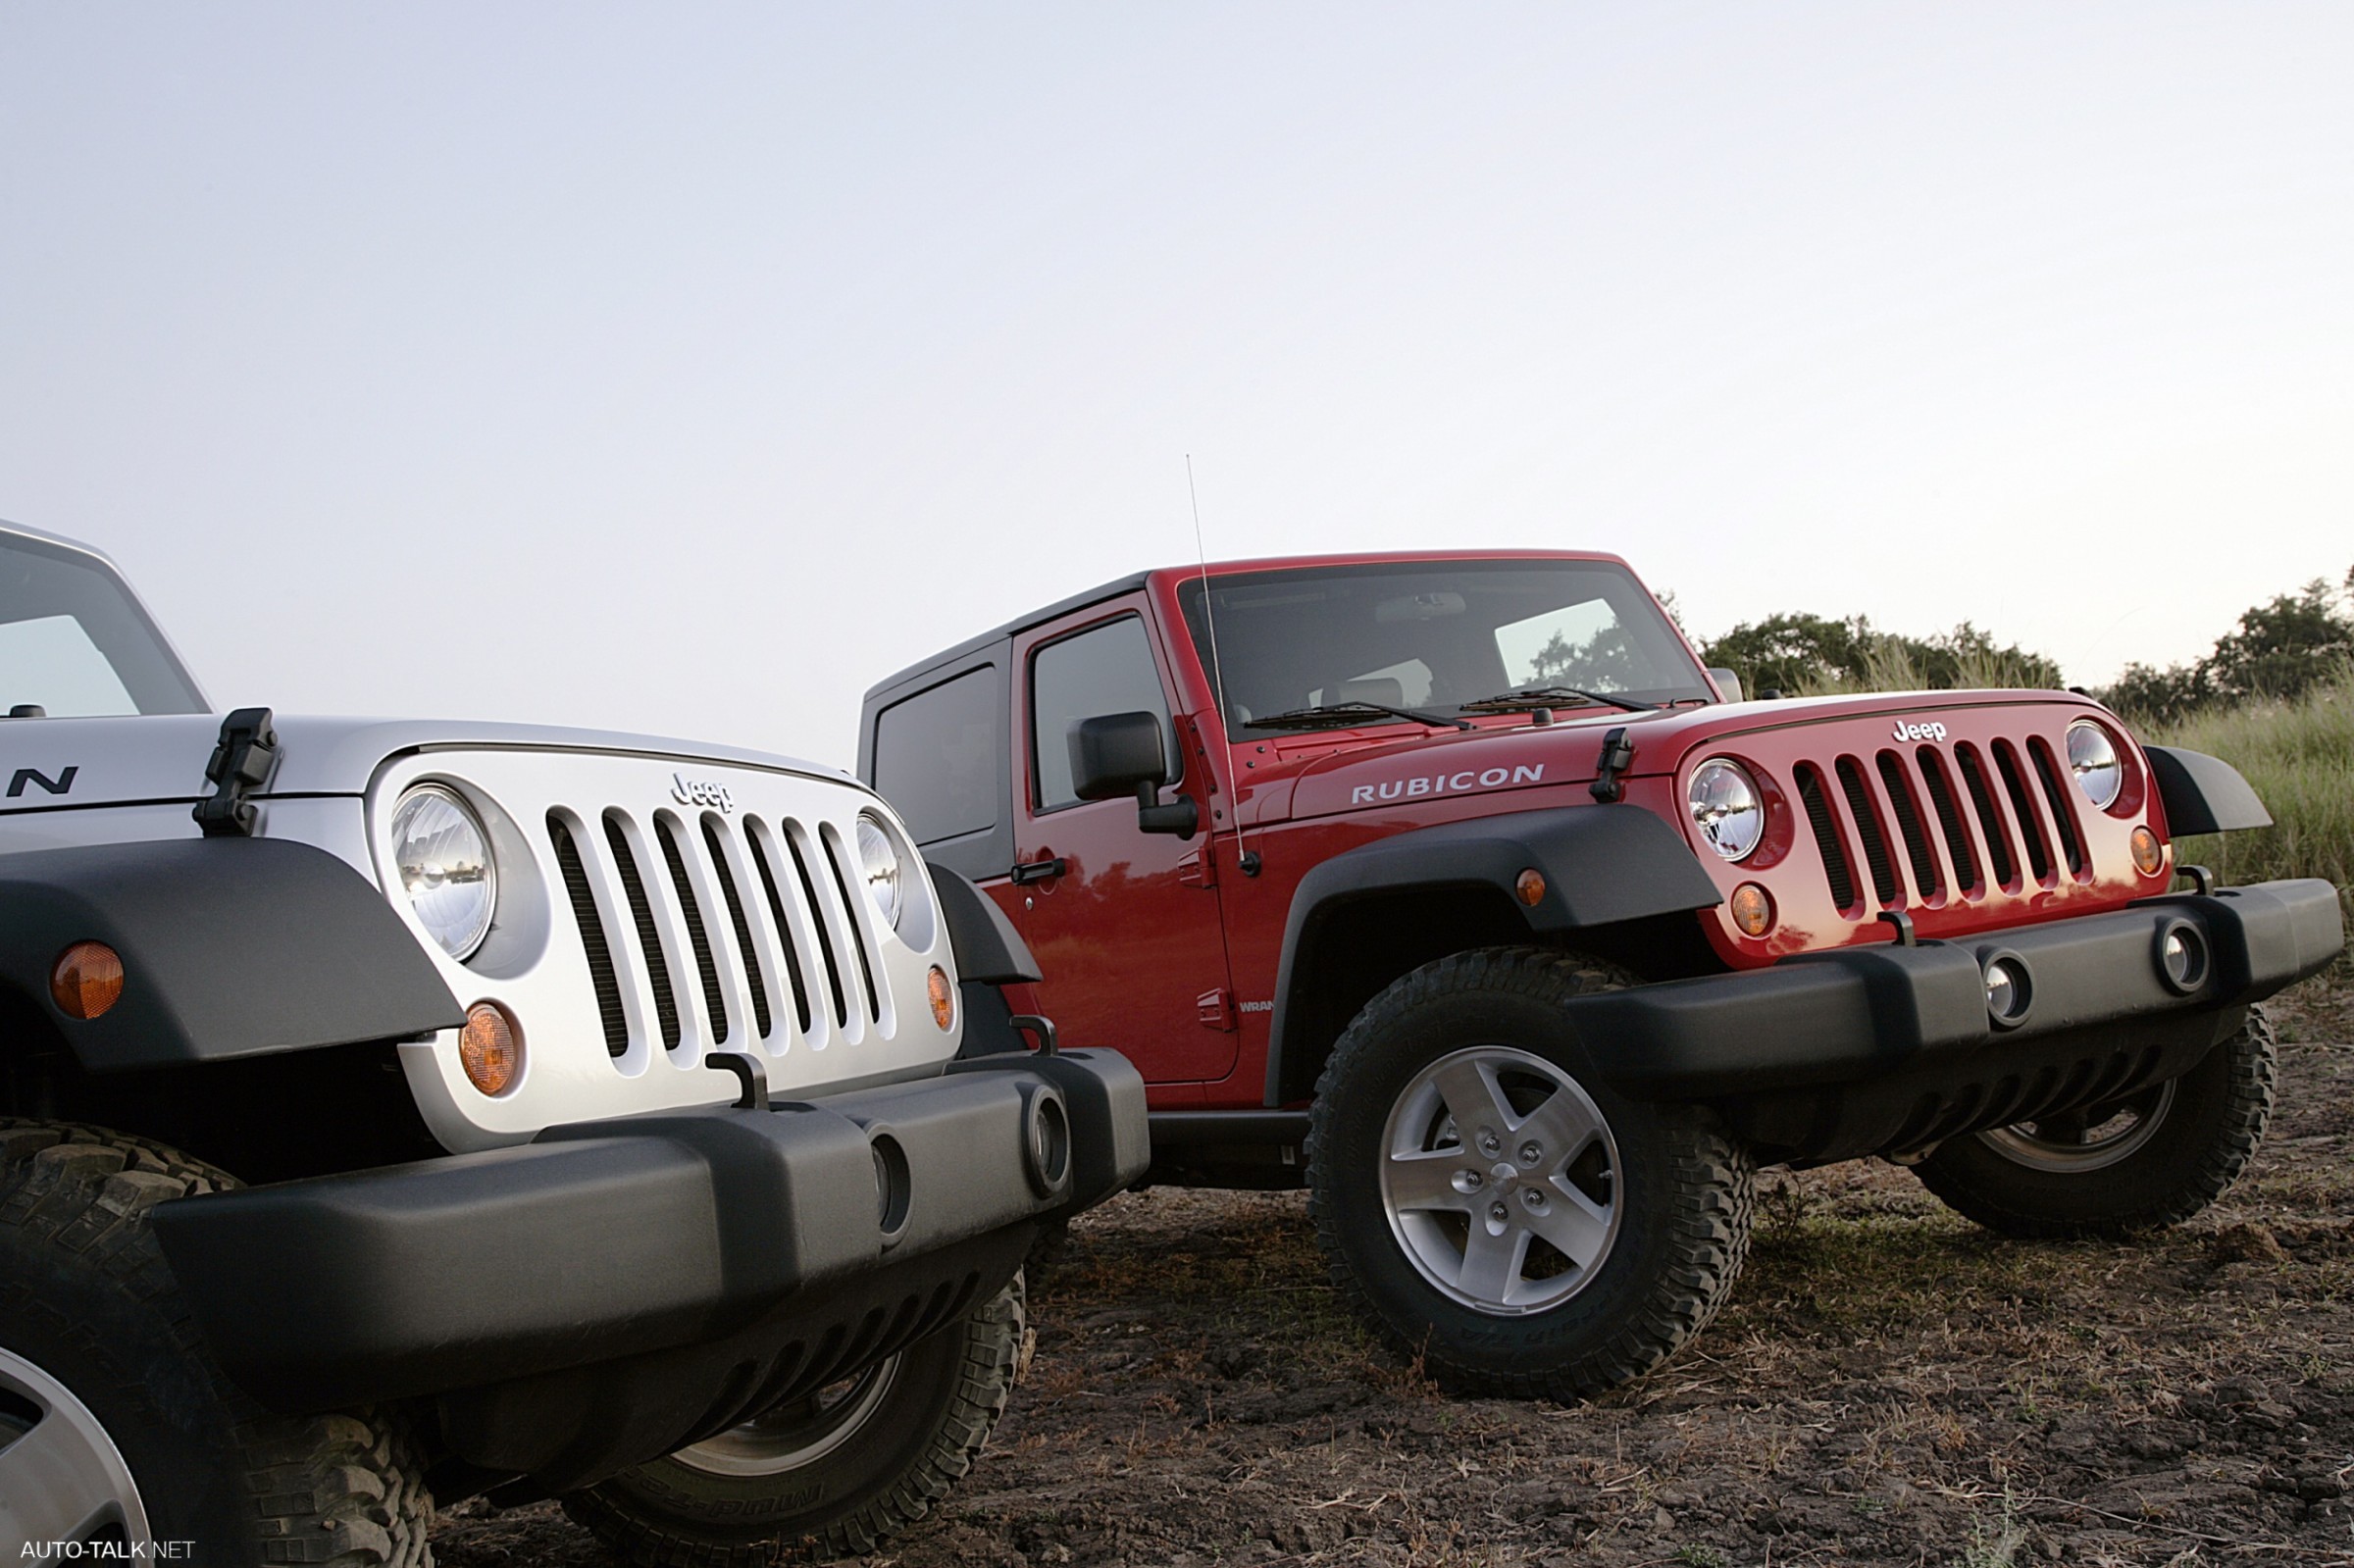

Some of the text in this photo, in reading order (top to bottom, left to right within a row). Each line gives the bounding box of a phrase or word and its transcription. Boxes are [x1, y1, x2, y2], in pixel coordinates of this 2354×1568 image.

[1892, 720, 1947, 742] Jeep
[6, 766, 79, 797] N
[670, 772, 734, 814] Jeep
[1352, 764, 1545, 804] RUBICON
